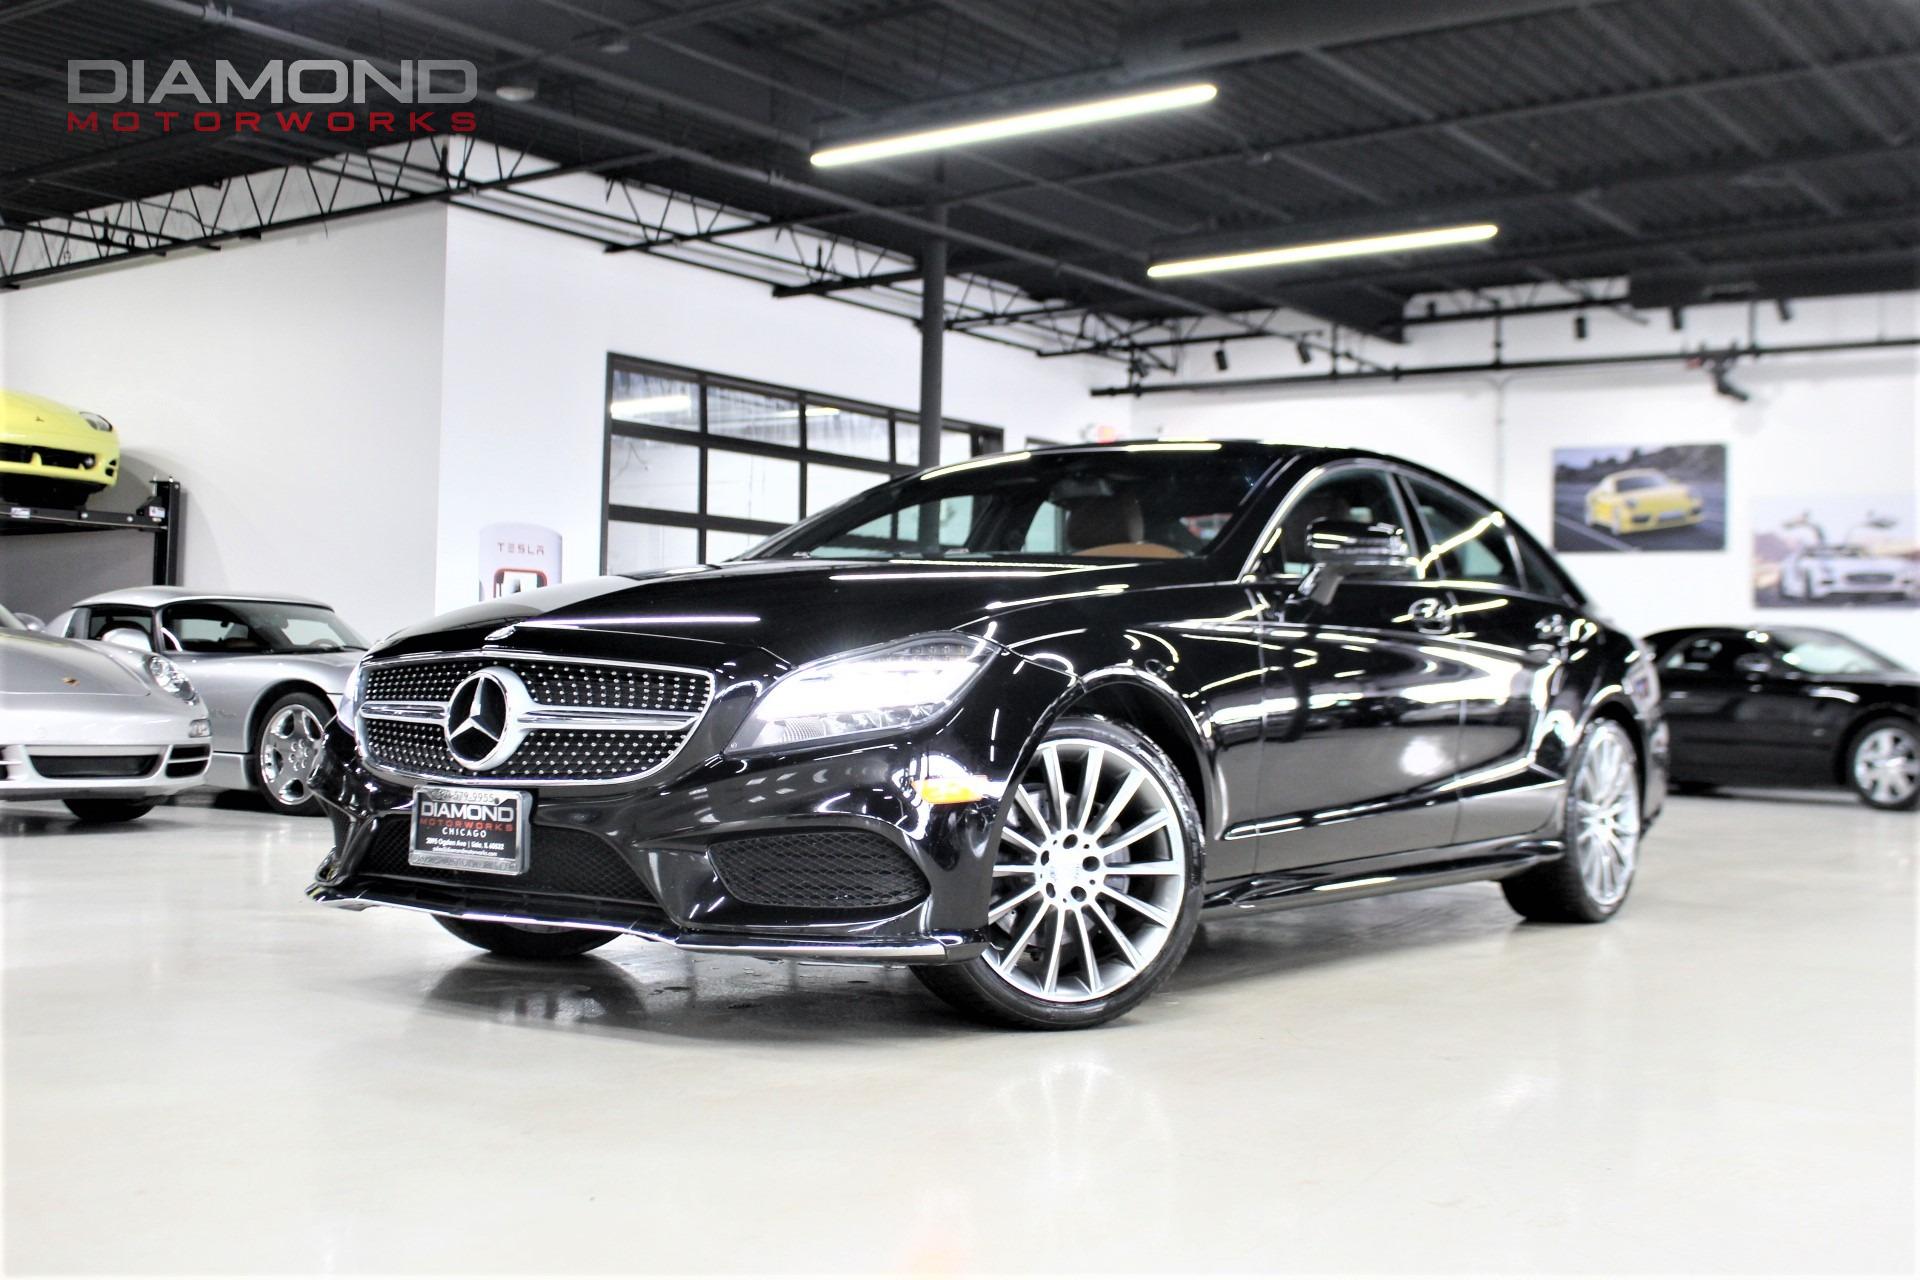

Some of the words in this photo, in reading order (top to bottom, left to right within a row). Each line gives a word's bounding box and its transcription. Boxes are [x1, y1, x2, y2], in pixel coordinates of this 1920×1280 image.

[497, 542, 545, 556] TESLA
[421, 801, 514, 822] DIAMOND
[421, 818, 513, 832] MOTORWORKS
[442, 827, 487, 838] CHICAGO
[456, 839, 467, 847] Ave
